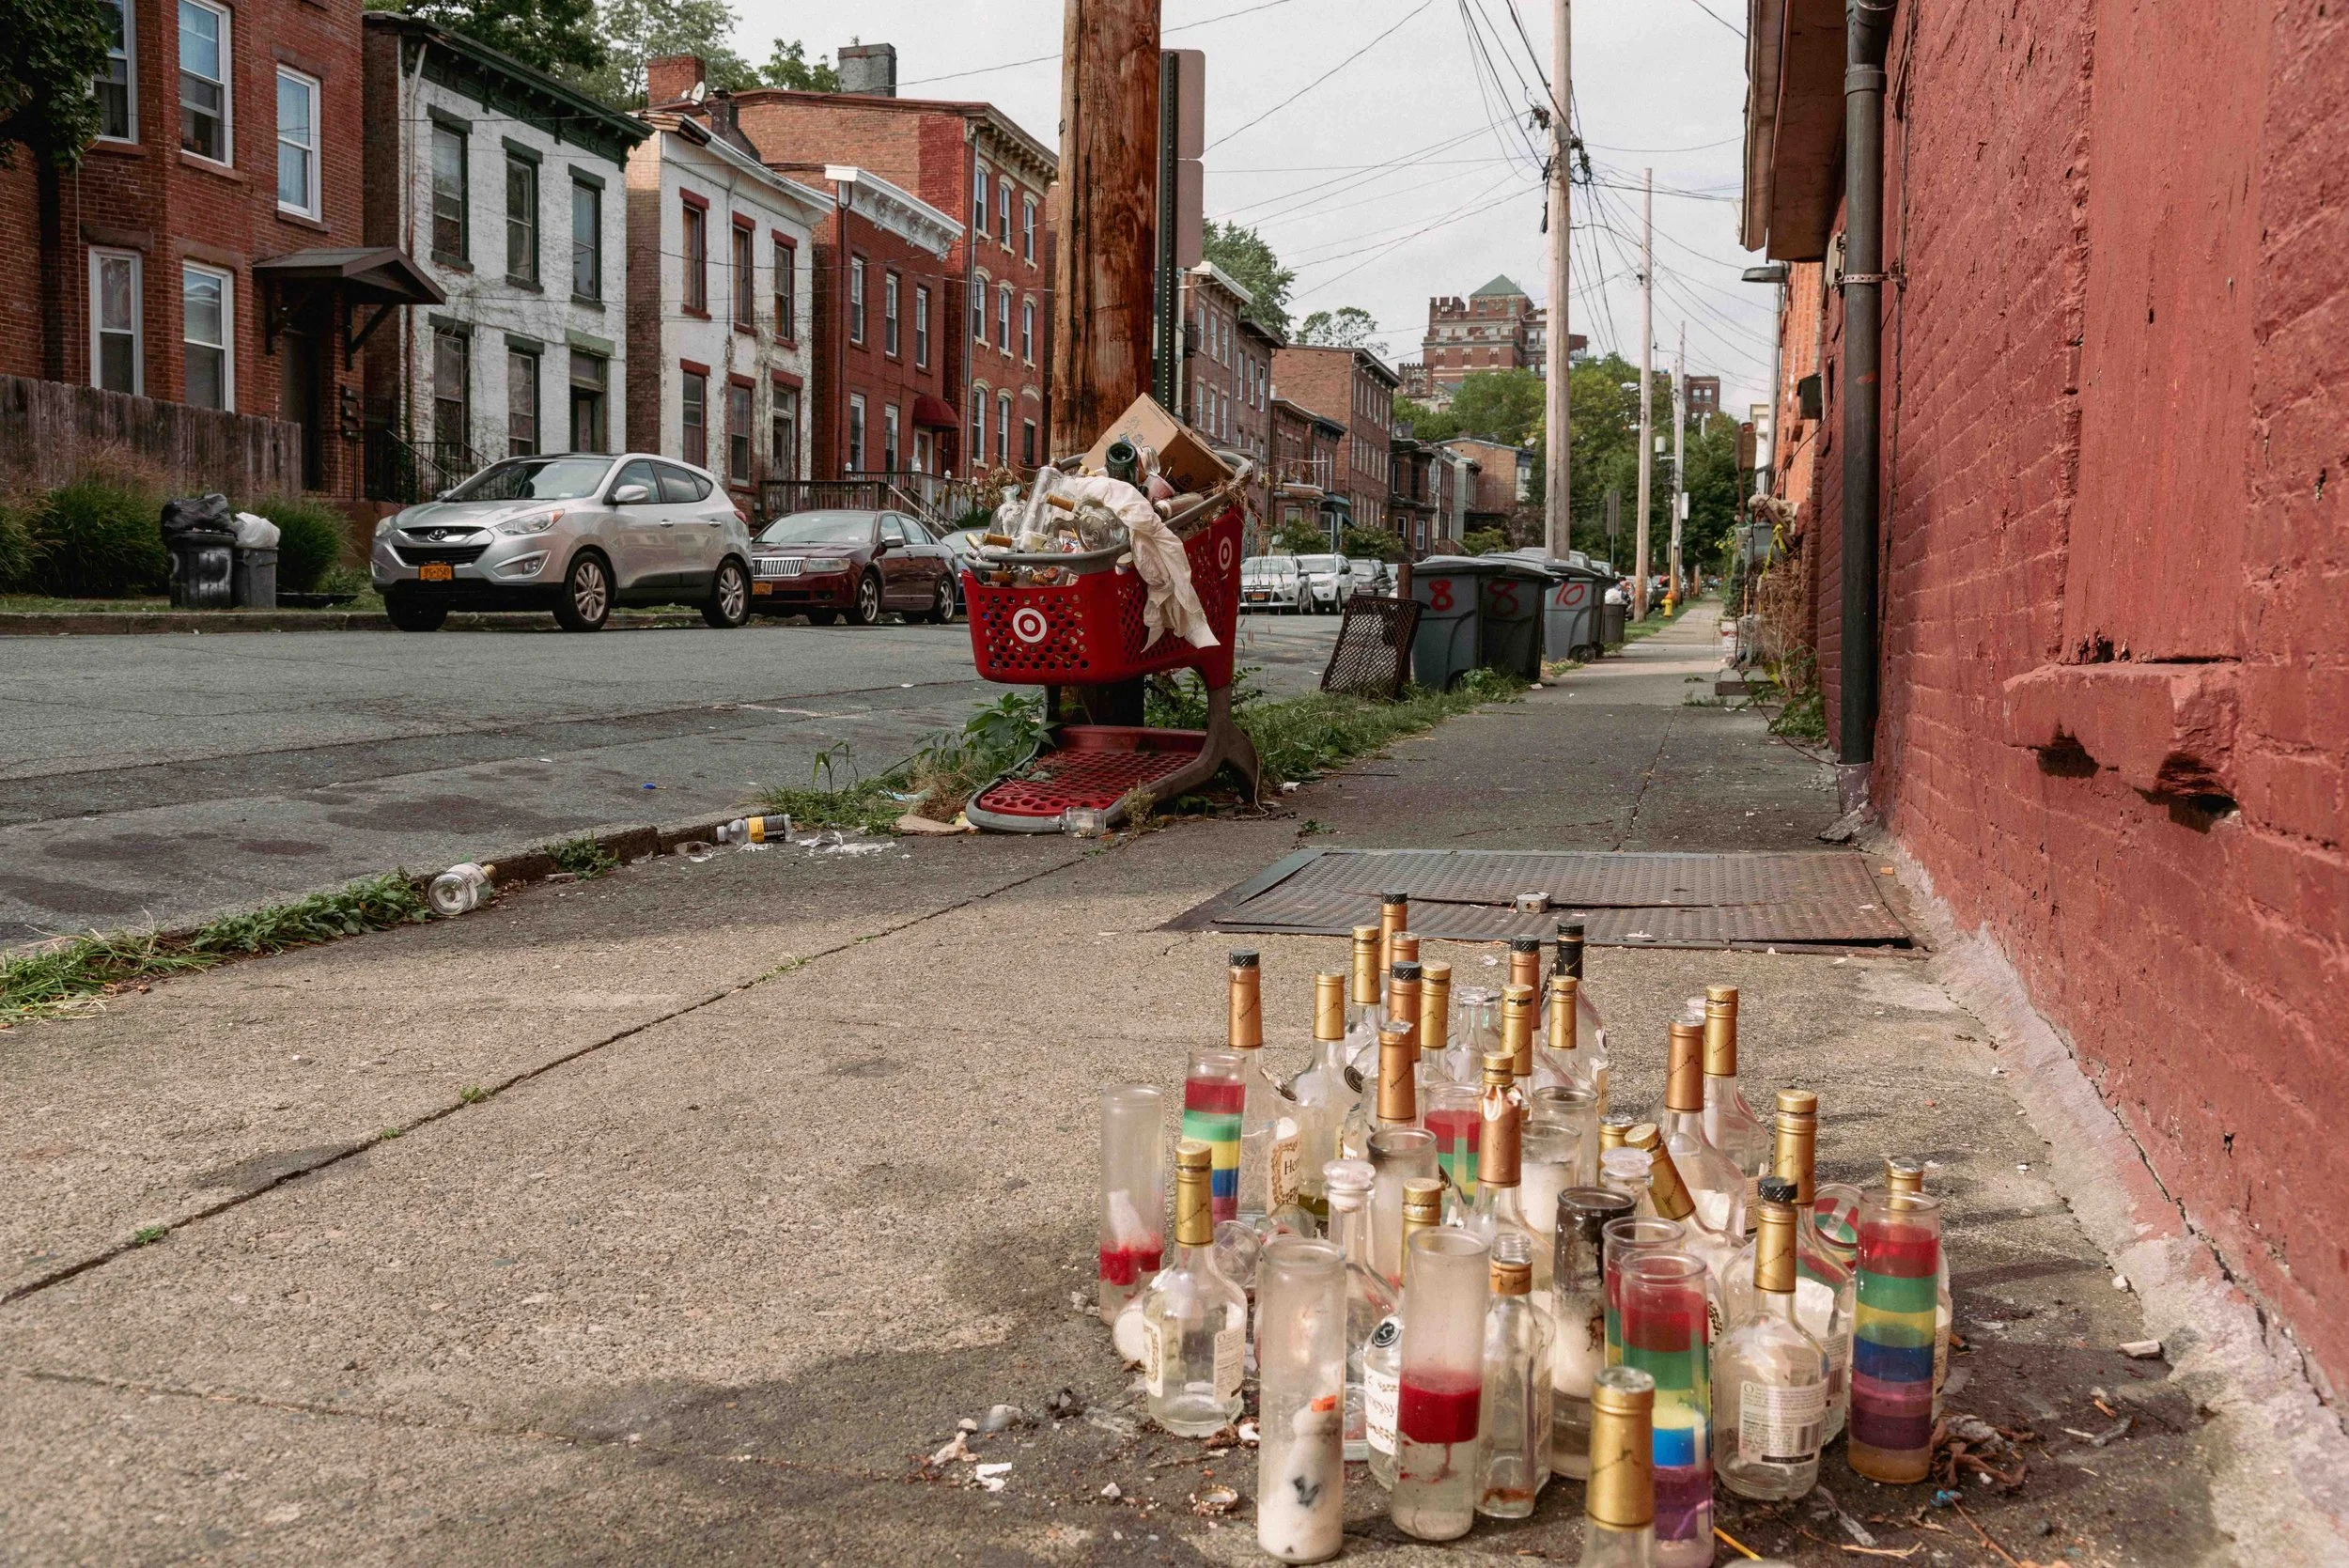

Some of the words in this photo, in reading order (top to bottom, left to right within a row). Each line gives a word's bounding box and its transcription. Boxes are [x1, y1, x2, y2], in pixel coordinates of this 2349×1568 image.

[1428, 579, 1454, 612] 8
[1487, 579, 1519, 617] 8
[1555, 582, 1585, 606] 10
